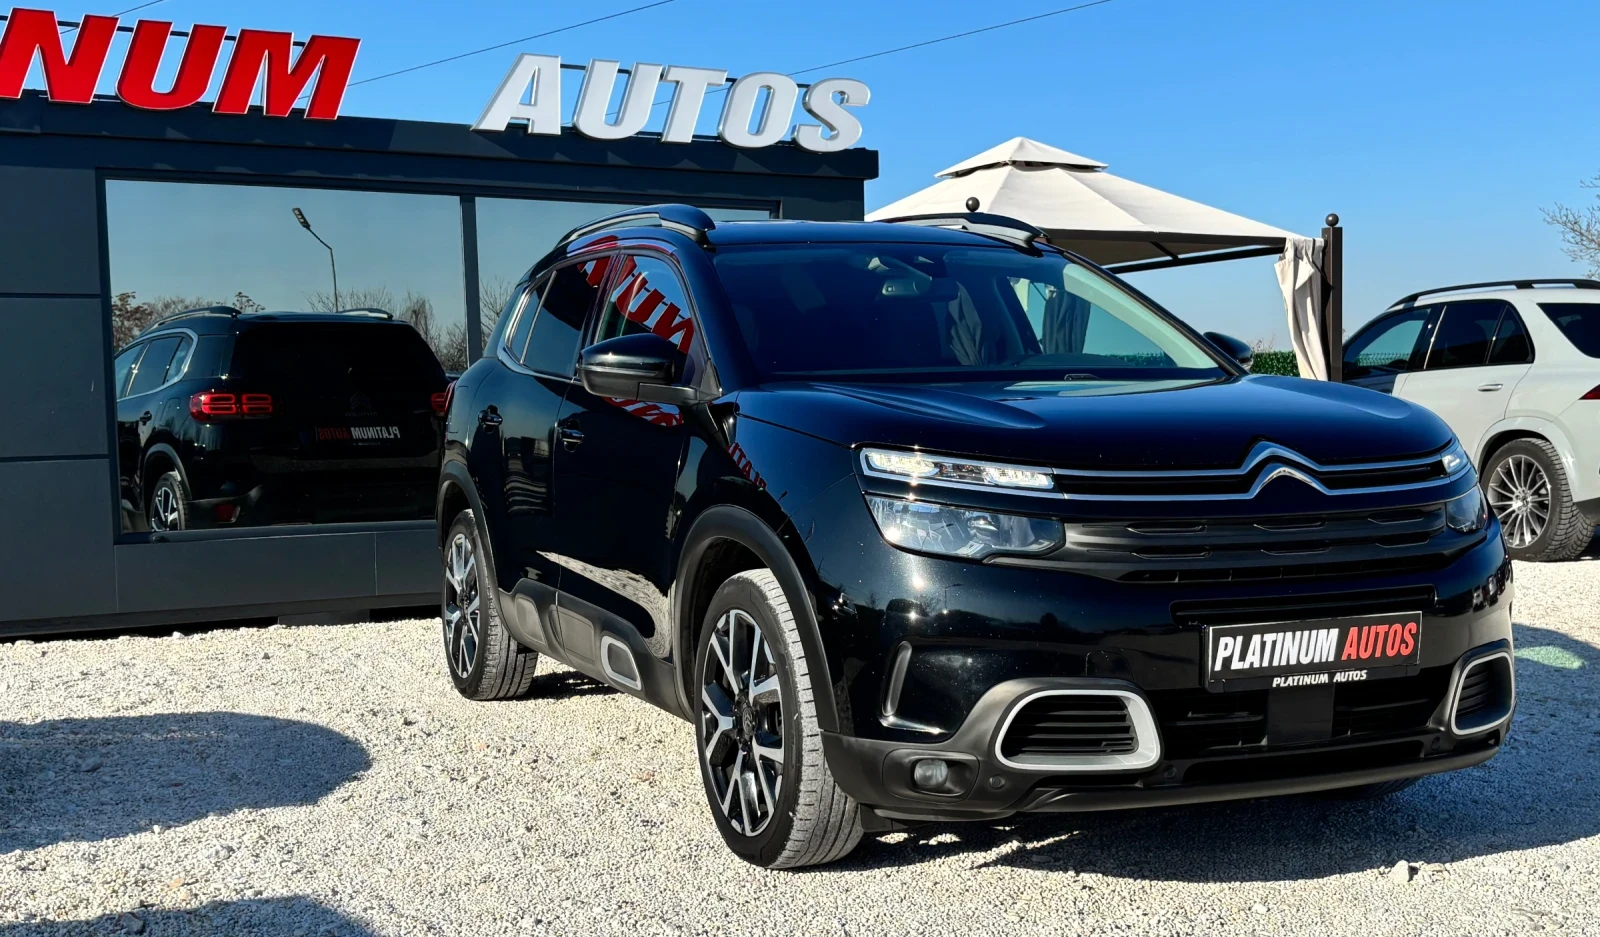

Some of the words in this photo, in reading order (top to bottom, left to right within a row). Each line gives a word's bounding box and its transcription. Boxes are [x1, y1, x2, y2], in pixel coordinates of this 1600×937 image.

[470, 53, 871, 153] AUTOS
[1214, 628, 1339, 672] PLATINUM
[1341, 622, 1417, 661] AUTOS
[1272, 674, 1329, 688] PLATINUM
[1333, 670, 1368, 683] AUTOS
